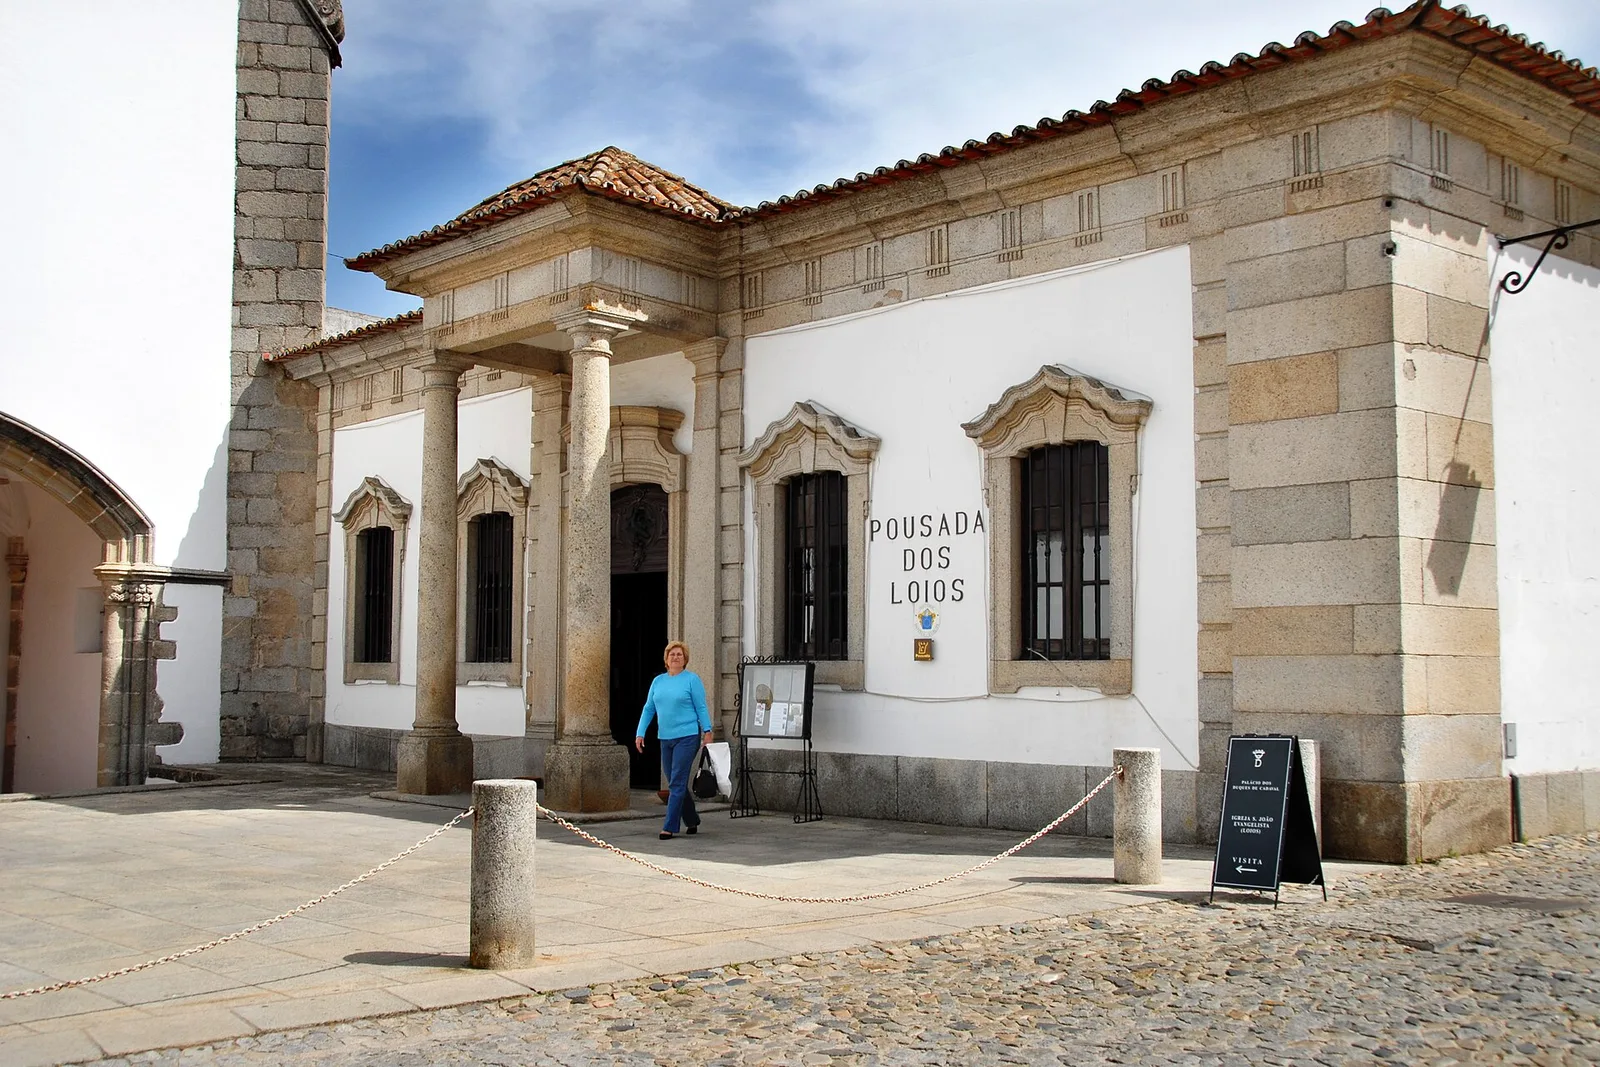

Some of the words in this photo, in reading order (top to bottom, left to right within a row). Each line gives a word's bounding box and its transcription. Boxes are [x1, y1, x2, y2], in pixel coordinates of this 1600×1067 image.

[870, 510, 985, 542] POUSADA
[903, 546, 951, 572] DOS
[891, 578, 965, 605] LOIOS
[1233, 821, 1270, 829] EVANGELISTA
[1259, 815, 1274, 823] JOÃO
[1232, 856, 1263, 865] VISITA
